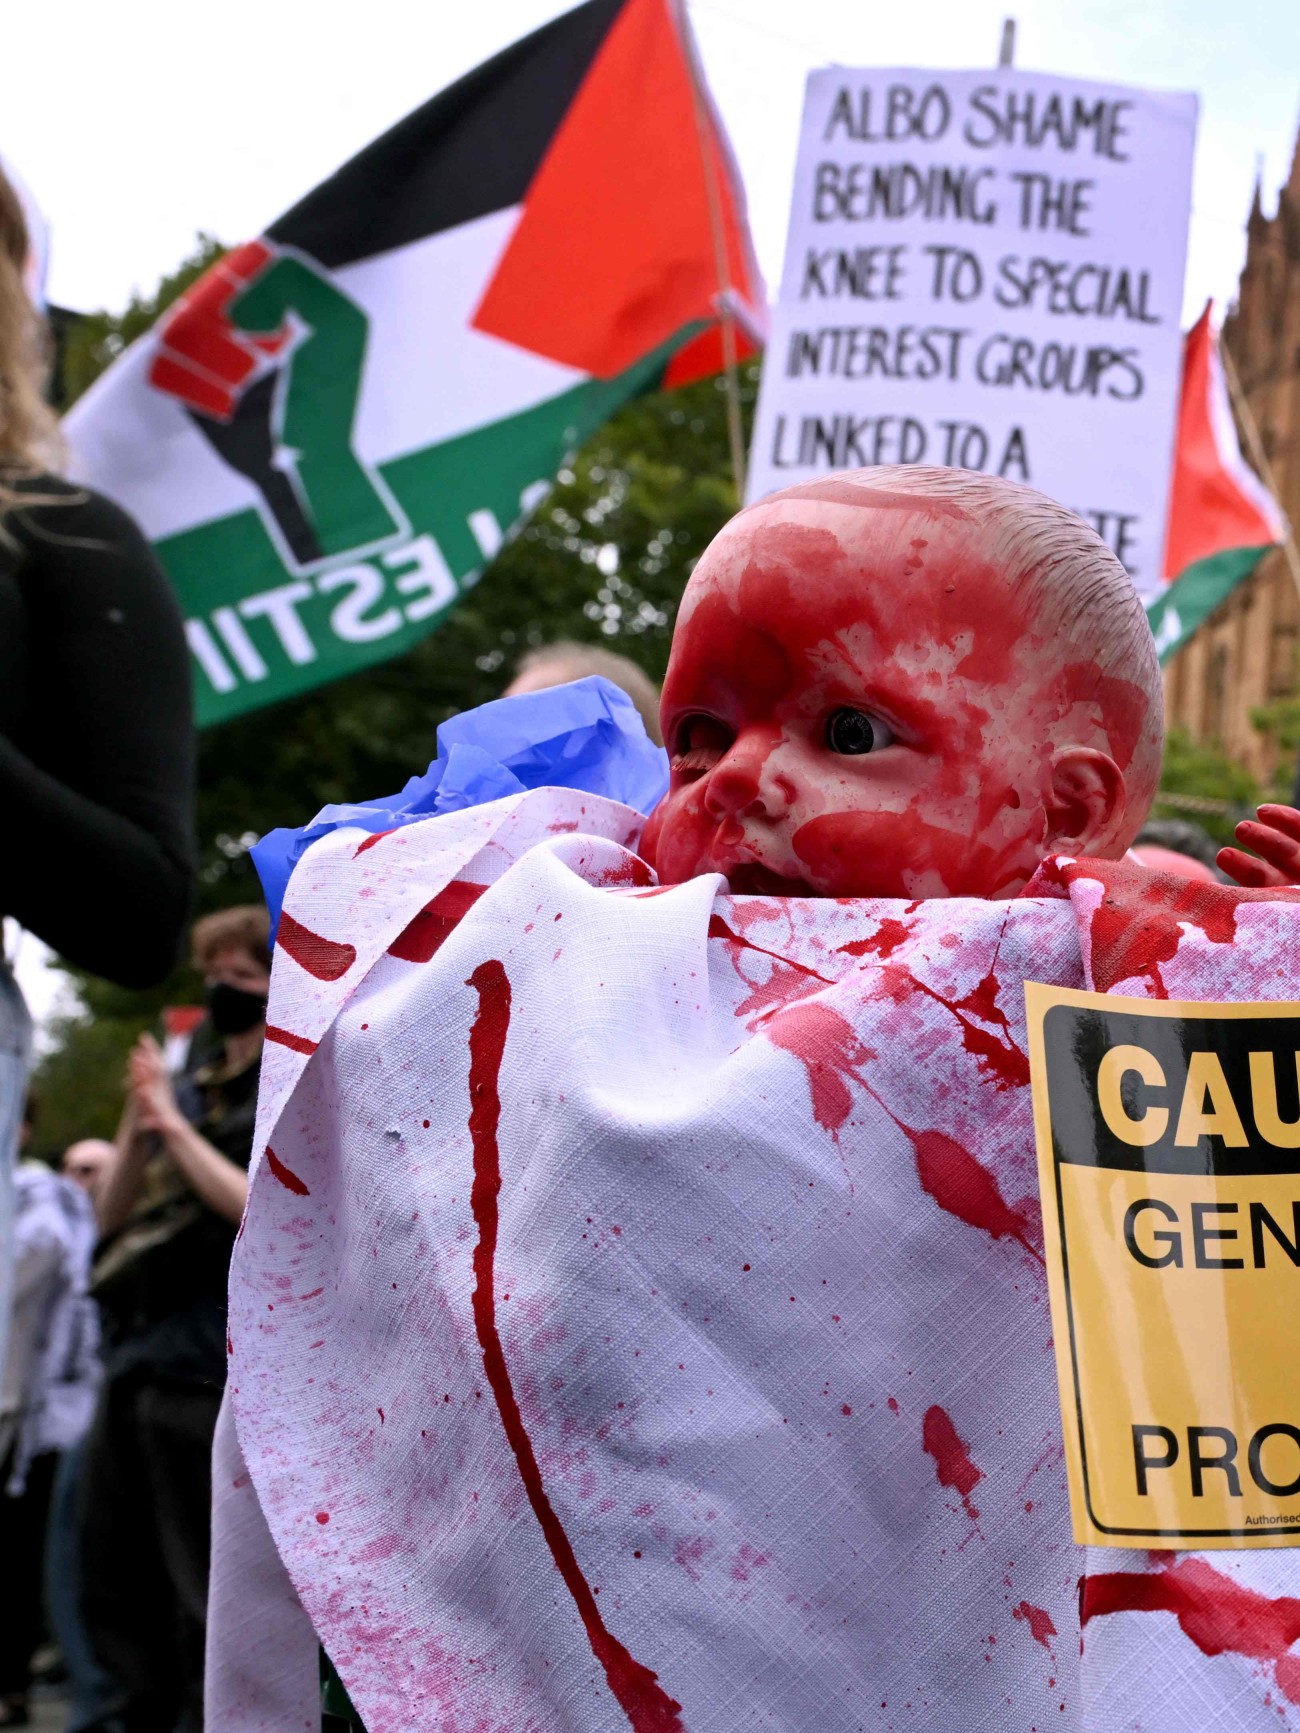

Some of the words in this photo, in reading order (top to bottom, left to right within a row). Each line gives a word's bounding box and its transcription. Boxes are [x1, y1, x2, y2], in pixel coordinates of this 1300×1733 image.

[822, 85, 950, 143] ALBO
[963, 88, 1132, 162] SHAME
[812, 161, 995, 223] BENDING
[1012, 172, 1095, 236] THE
[800, 247, 907, 301] KNEE
[923, 245, 984, 301] TO
[998, 257, 1160, 324] SPECIAL
[786, 326, 977, 380] INTEREST
[977, 334, 1144, 400] GROUPS
[772, 413, 927, 468] LINKED
[936, 420, 988, 471] TO
[997, 425, 1030, 480] A
